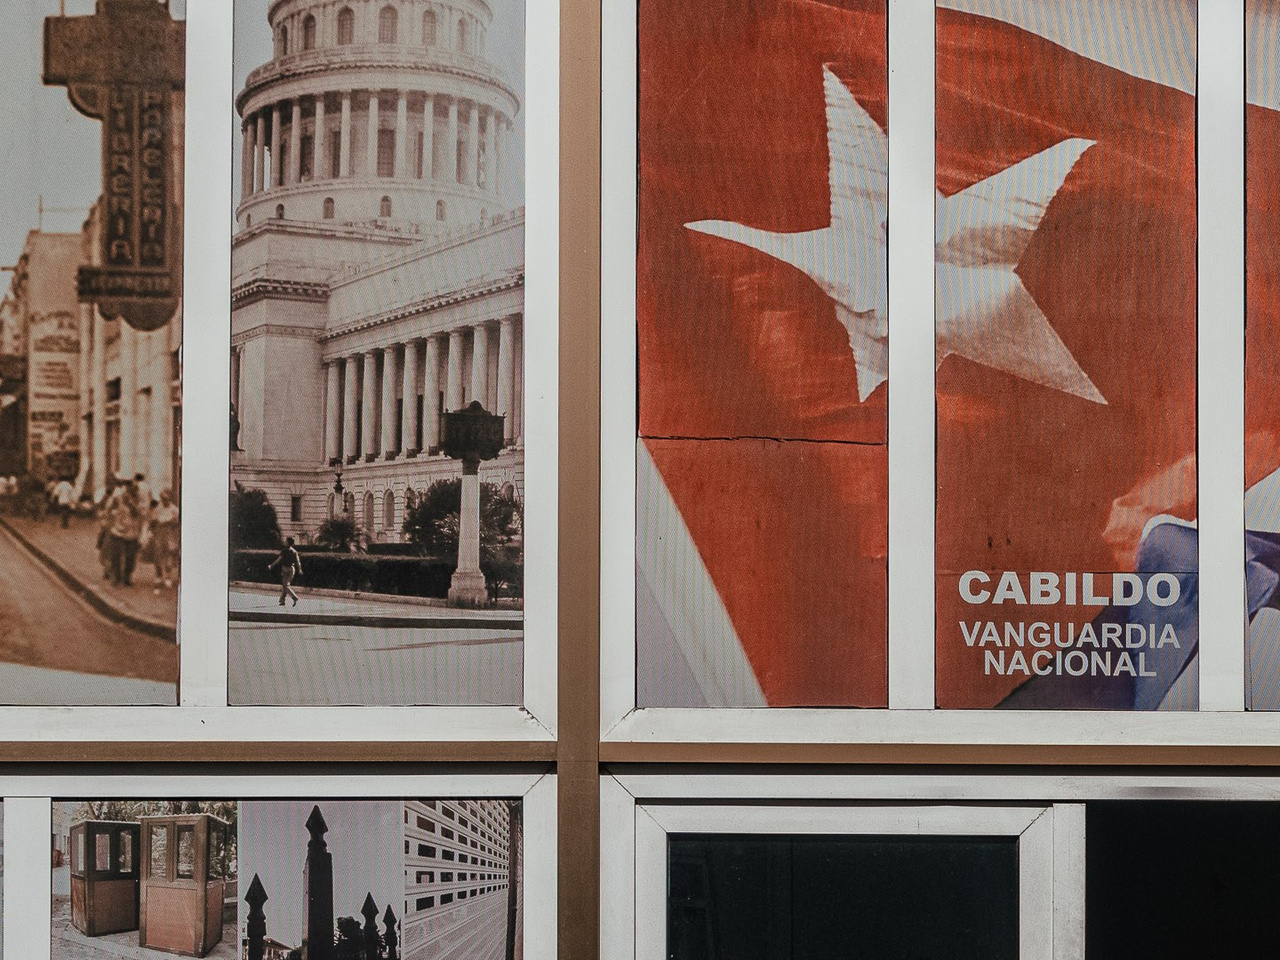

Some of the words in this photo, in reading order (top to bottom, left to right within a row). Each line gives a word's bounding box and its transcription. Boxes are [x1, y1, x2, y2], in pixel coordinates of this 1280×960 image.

[958, 570, 1181, 607] CABILDO
[959, 621, 1181, 649] VANGUARDIA
[984, 650, 1157, 677] NACIONAL
